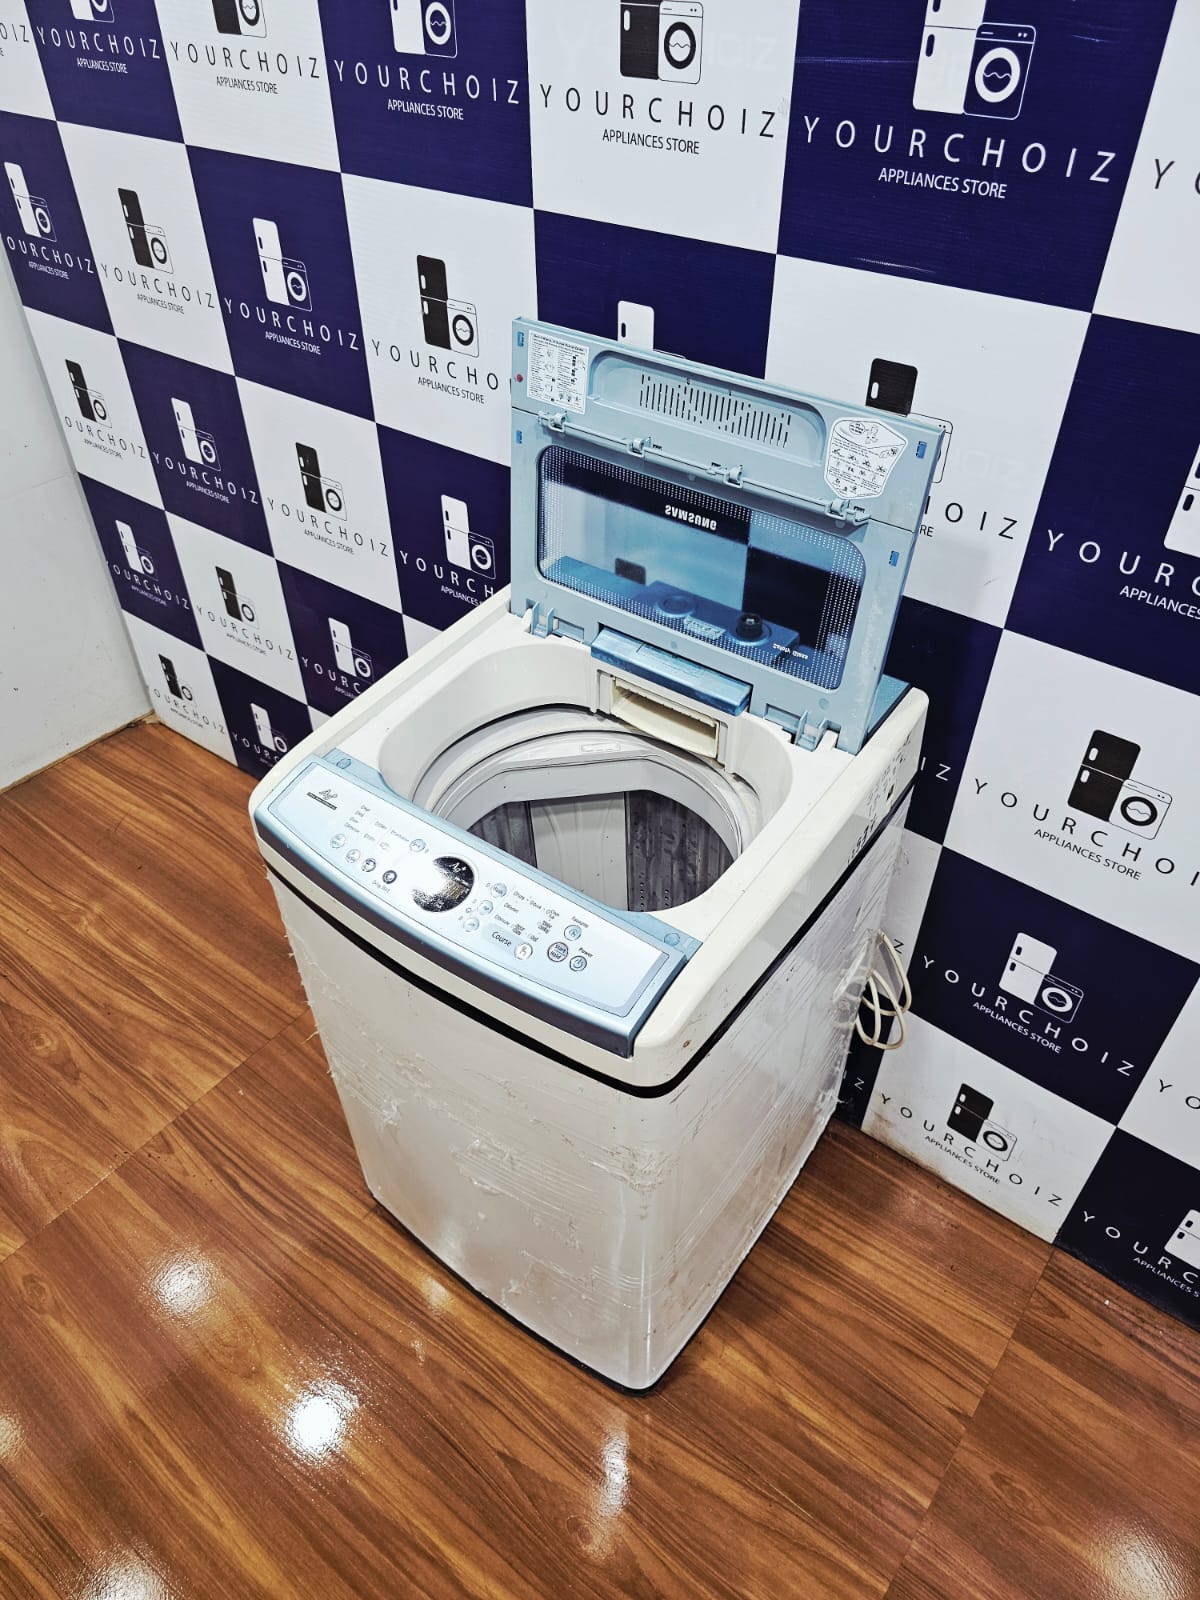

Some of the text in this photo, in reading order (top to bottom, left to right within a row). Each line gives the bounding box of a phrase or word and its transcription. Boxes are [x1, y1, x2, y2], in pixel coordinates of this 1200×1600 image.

[36, 26, 161, 60] YOURCHOIZ
[169, 41, 320, 79] YOURCHOIZ
[109, 61, 129, 74] STORE
[216, 76, 278, 95] APPLIANCES STORE
[334, 59, 520, 104] YOURCHOIZ
[387, 99, 464, 120] APPLIANCES STORE
[539, 83, 776, 138] YOURCHOIZ
[602, 128, 700, 155] APPLIANCES STORE
[803, 115, 1116, 184] YOURCHOIZ
[878, 167, 1007, 199] APPLIANCES STORE
[101, 263, 215, 309] YOURCHOIZ
[223, 297, 360, 351] YOURCHOIZ
[265, 331, 321, 355] APPLIANCES STORE
[418, 376, 485, 405] APPLIANCES STORE
[152, 451, 259, 505] YOURCHOIZ
[267, 497, 389, 557] YOURCHOIZ
[196, 604, 294, 661] YOURCHOIZ
[1034, 829, 1142, 881] APPLIANCES STORE
[491, 931, 512, 947] Course
[923, 955, 1135, 1077] YOURCHOIZ
[972, 1001, 1062, 1054] APPLIANCES STORE
[880, 1093, 1063, 1207] YOURCHOIZ
[924, 1135, 1001, 1185] APPLIANCES STORE
[1132, 1256, 1192, 1293] APPLIANCES
